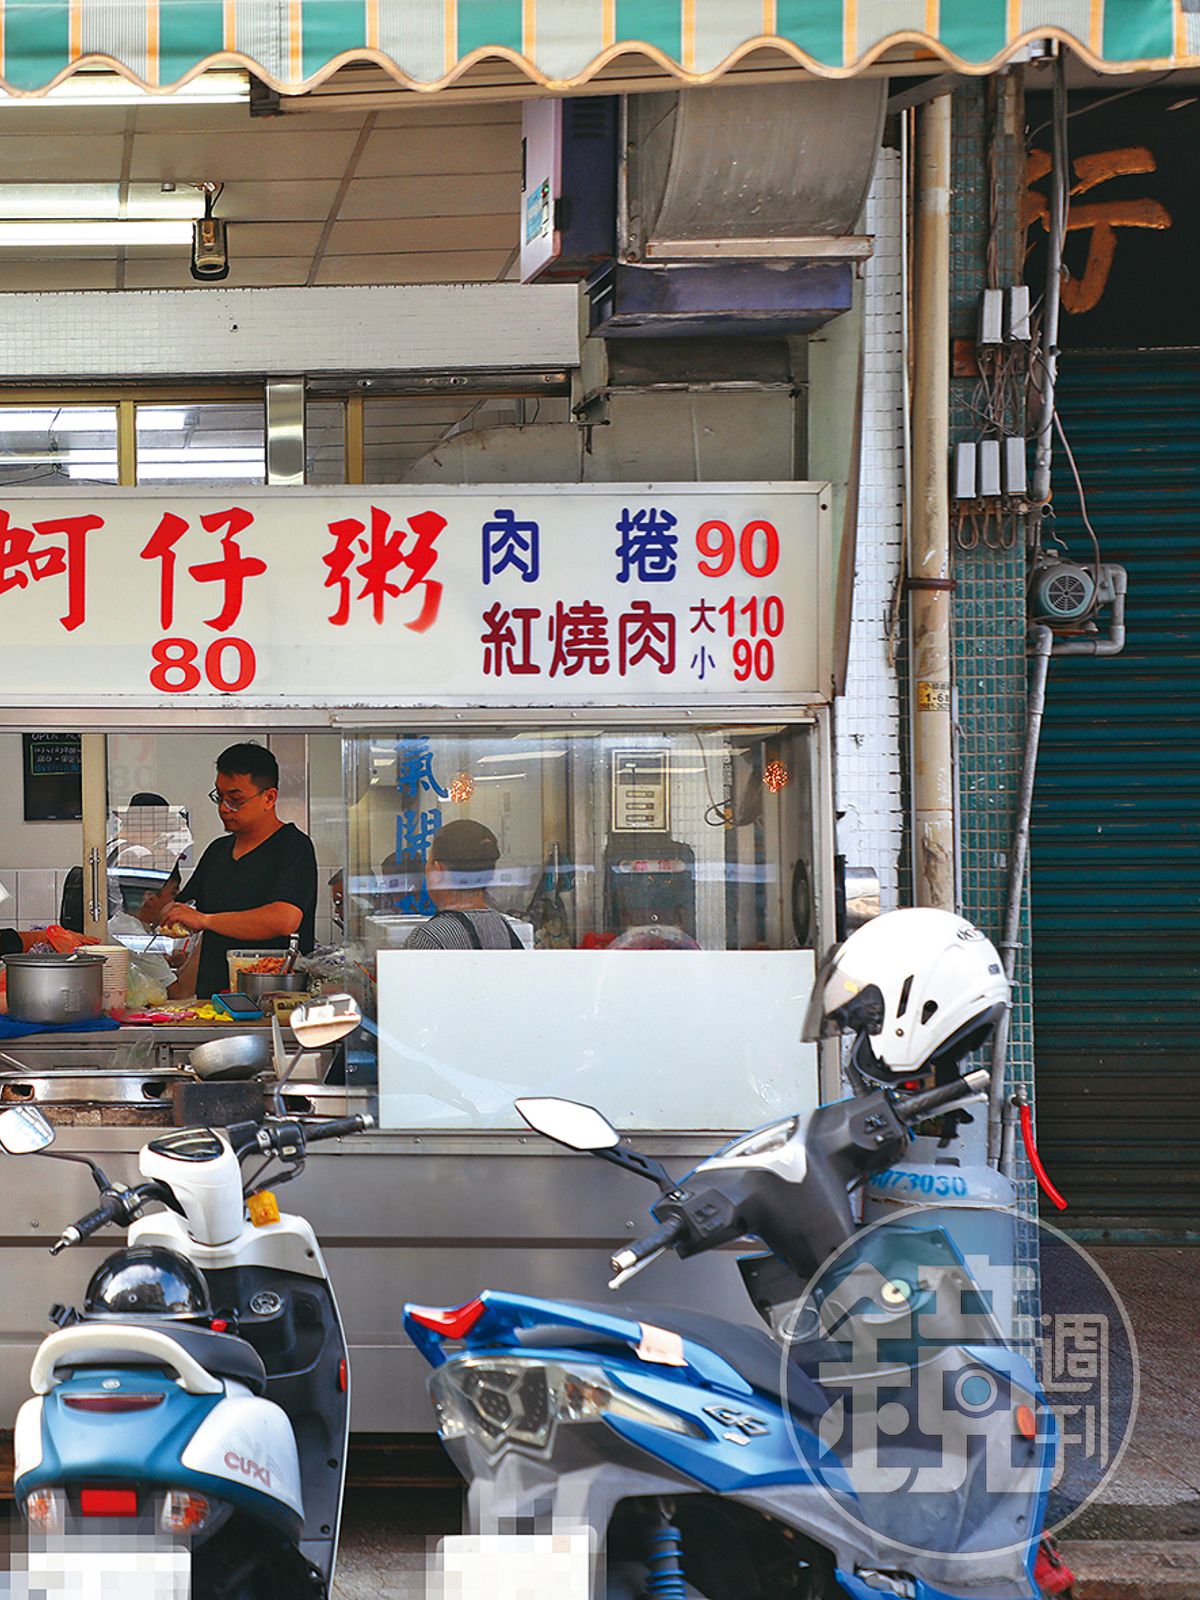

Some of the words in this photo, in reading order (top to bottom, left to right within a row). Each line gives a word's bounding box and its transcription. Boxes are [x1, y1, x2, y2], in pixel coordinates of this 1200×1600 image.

[482, 508, 679, 585] 肉捲
[696, 519, 781, 579] 90
[149, 637, 257, 693] 80
[482, 600, 676, 678] 紅燒肉
[689, 598, 716, 634] 大
[717, 596, 785, 640] 110
[690, 645, 716, 680] 小
[732, 640, 775, 682] 90
